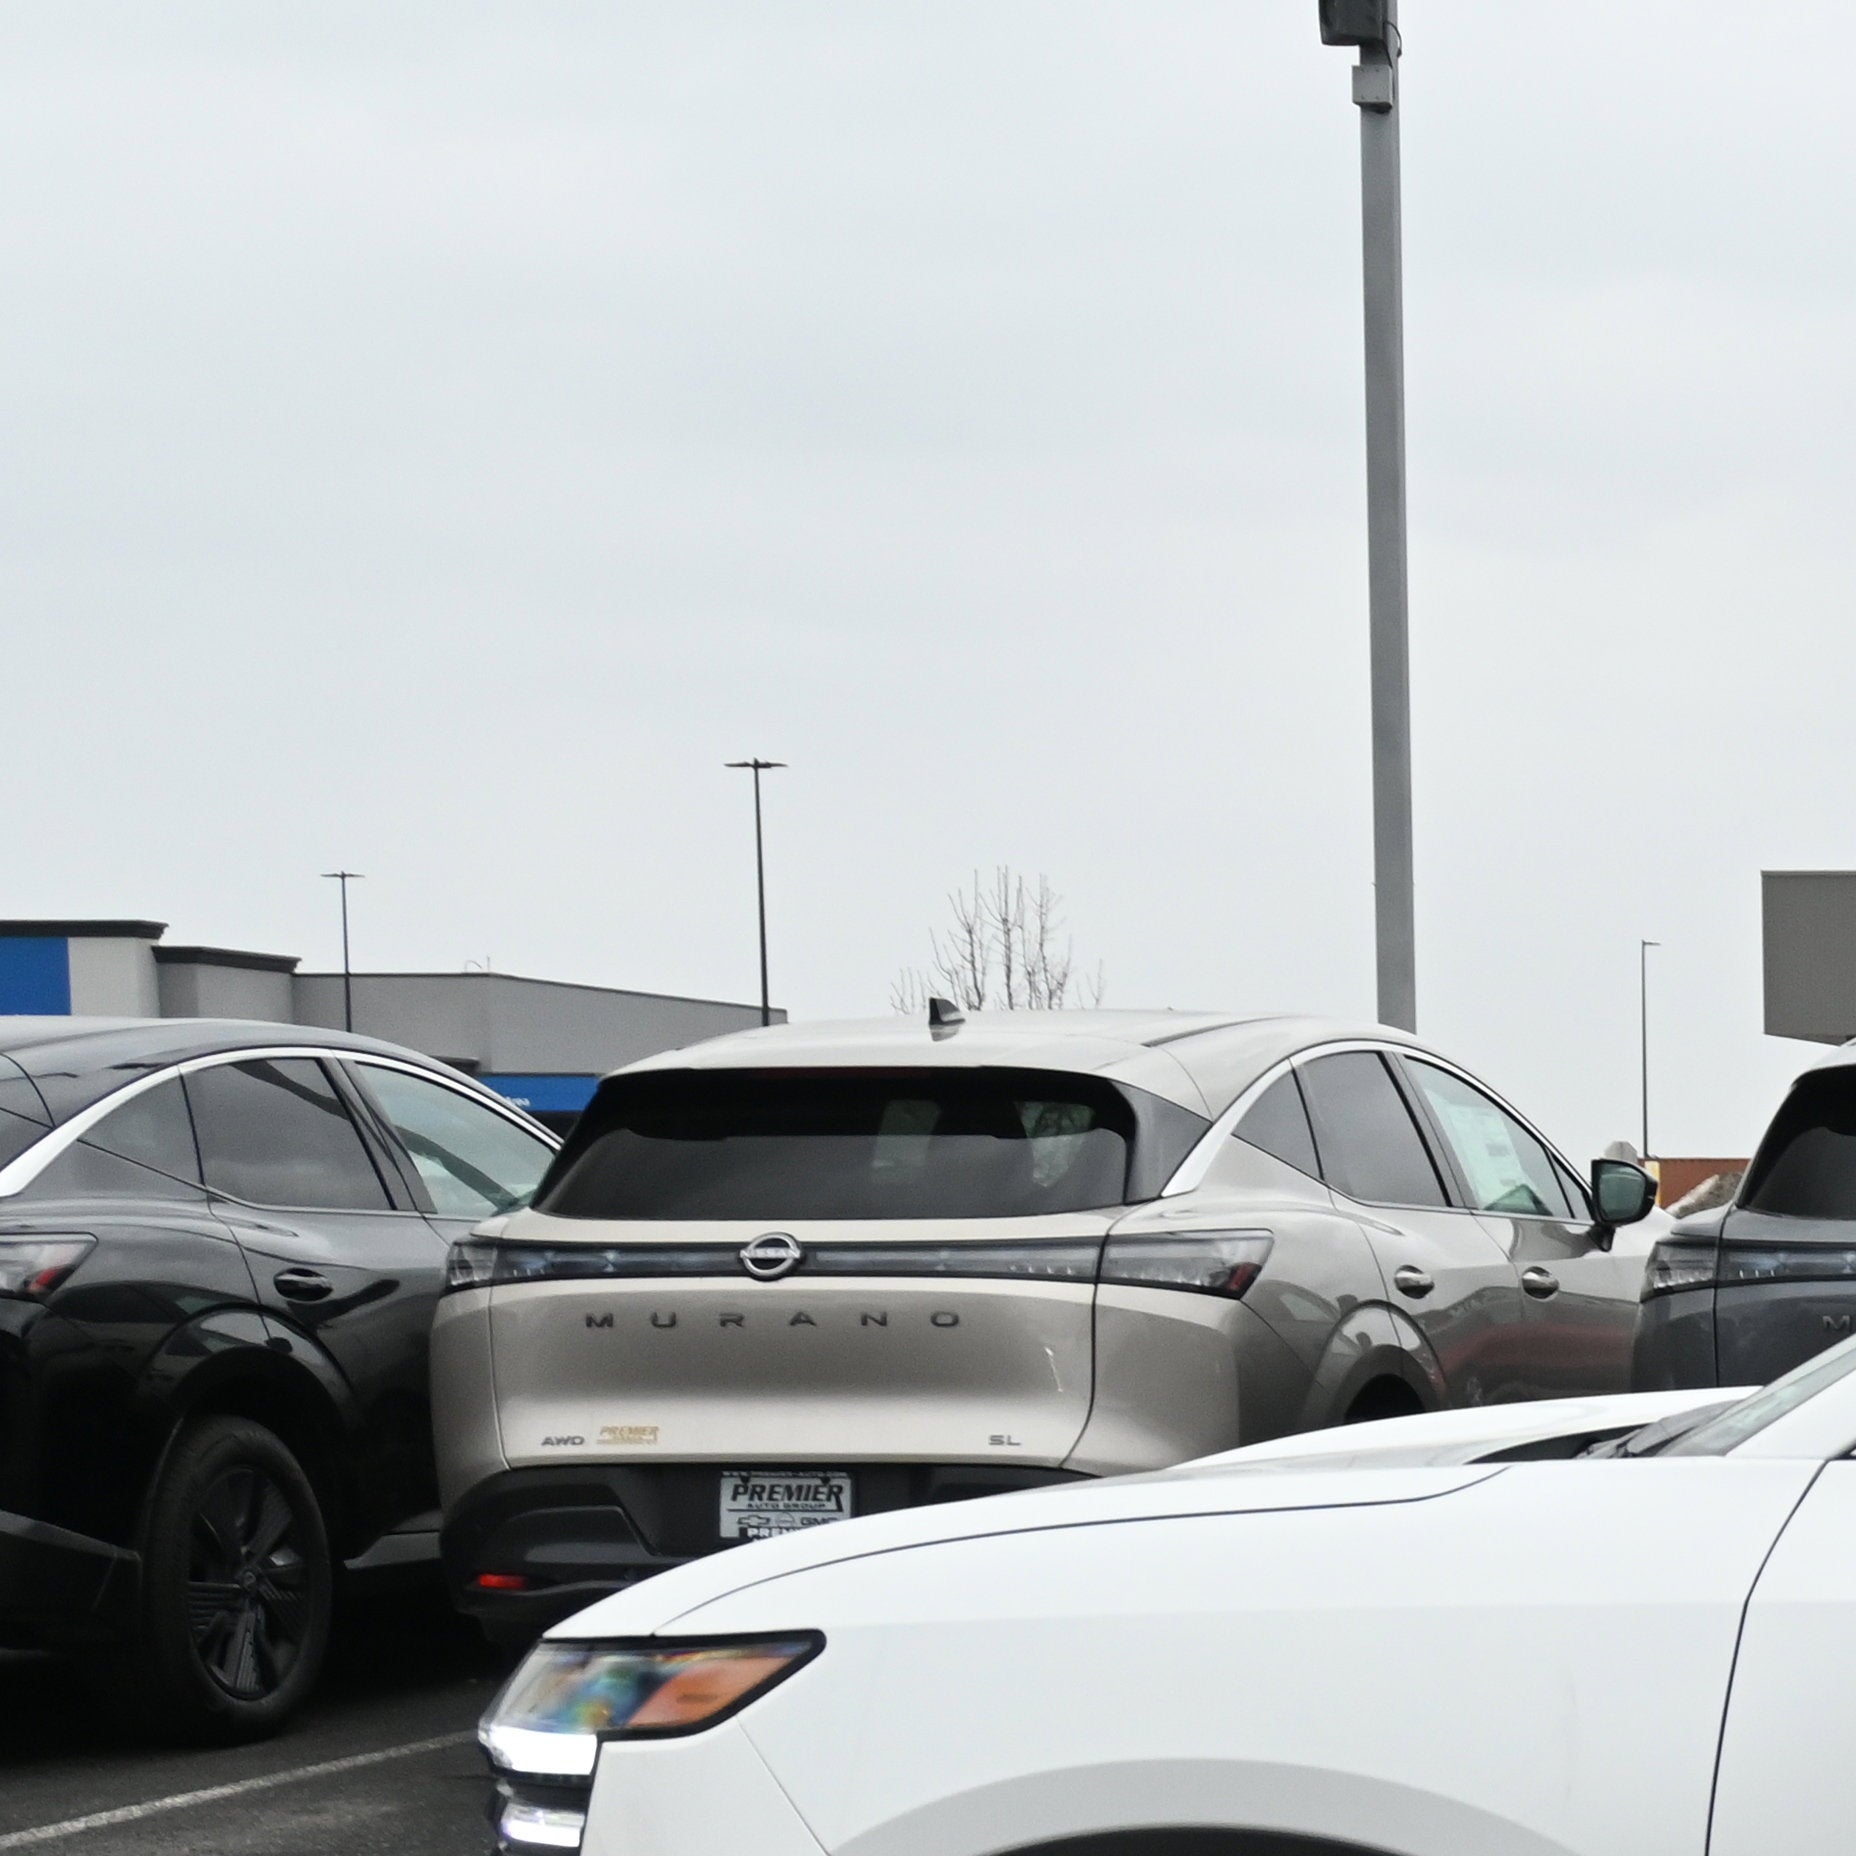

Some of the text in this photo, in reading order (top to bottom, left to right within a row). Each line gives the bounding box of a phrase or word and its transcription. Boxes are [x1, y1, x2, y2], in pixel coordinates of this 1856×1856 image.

[585, 1311, 960, 1329] MURANO
[541, 1435, 584, 1446] AWD
[988, 1434, 1021, 1446] SL
[731, 1483, 844, 1510] PREMIER
